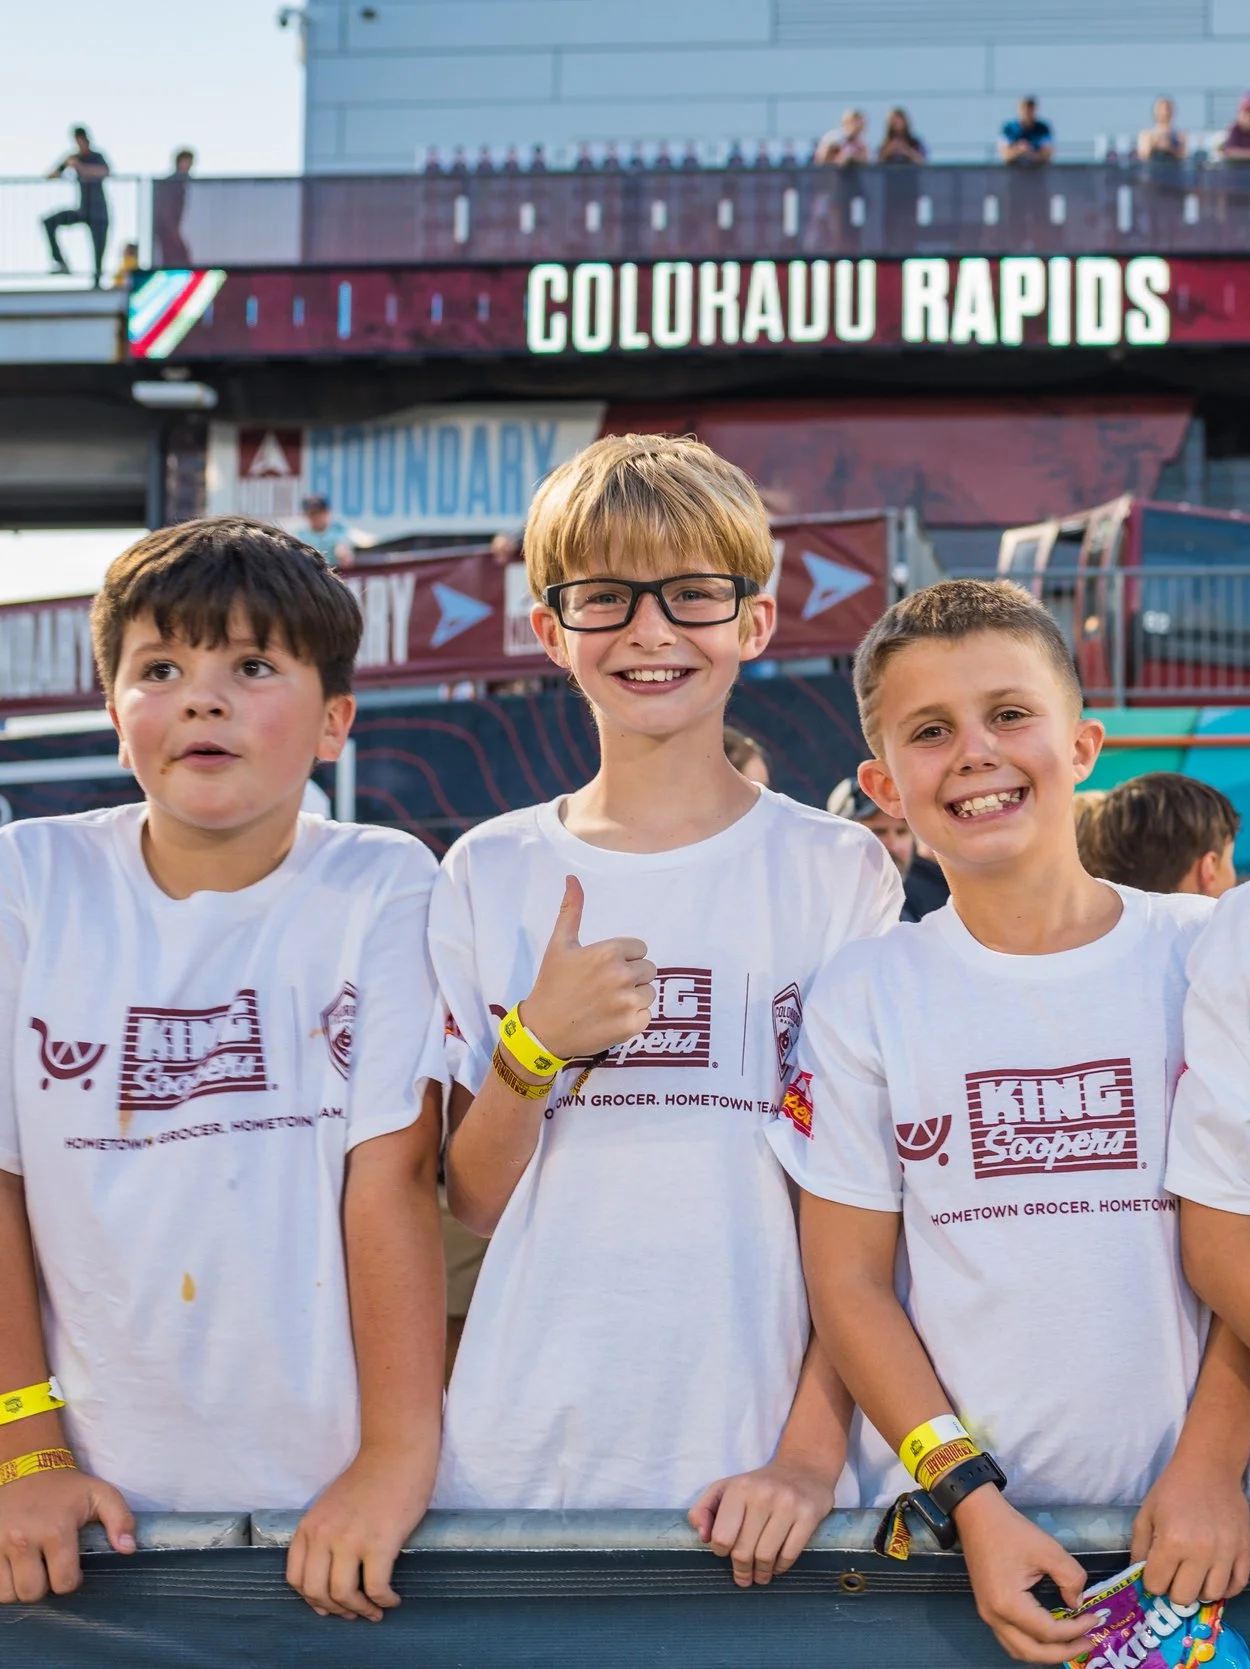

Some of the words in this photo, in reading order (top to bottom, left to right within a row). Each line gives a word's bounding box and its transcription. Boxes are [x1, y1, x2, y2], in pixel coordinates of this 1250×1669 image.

[901, 255, 1172, 347] RAPIDS
[591, 1094, 660, 1107] GROCER.
[665, 1094, 752, 1112] HOMETOWN
[978, 1070, 1123, 1126] KING
[982, 1124, 1127, 1171] Soopers
[930, 1203, 1019, 1226] HOMETOWN
[1023, 1199, 1095, 1218] GROCER.
